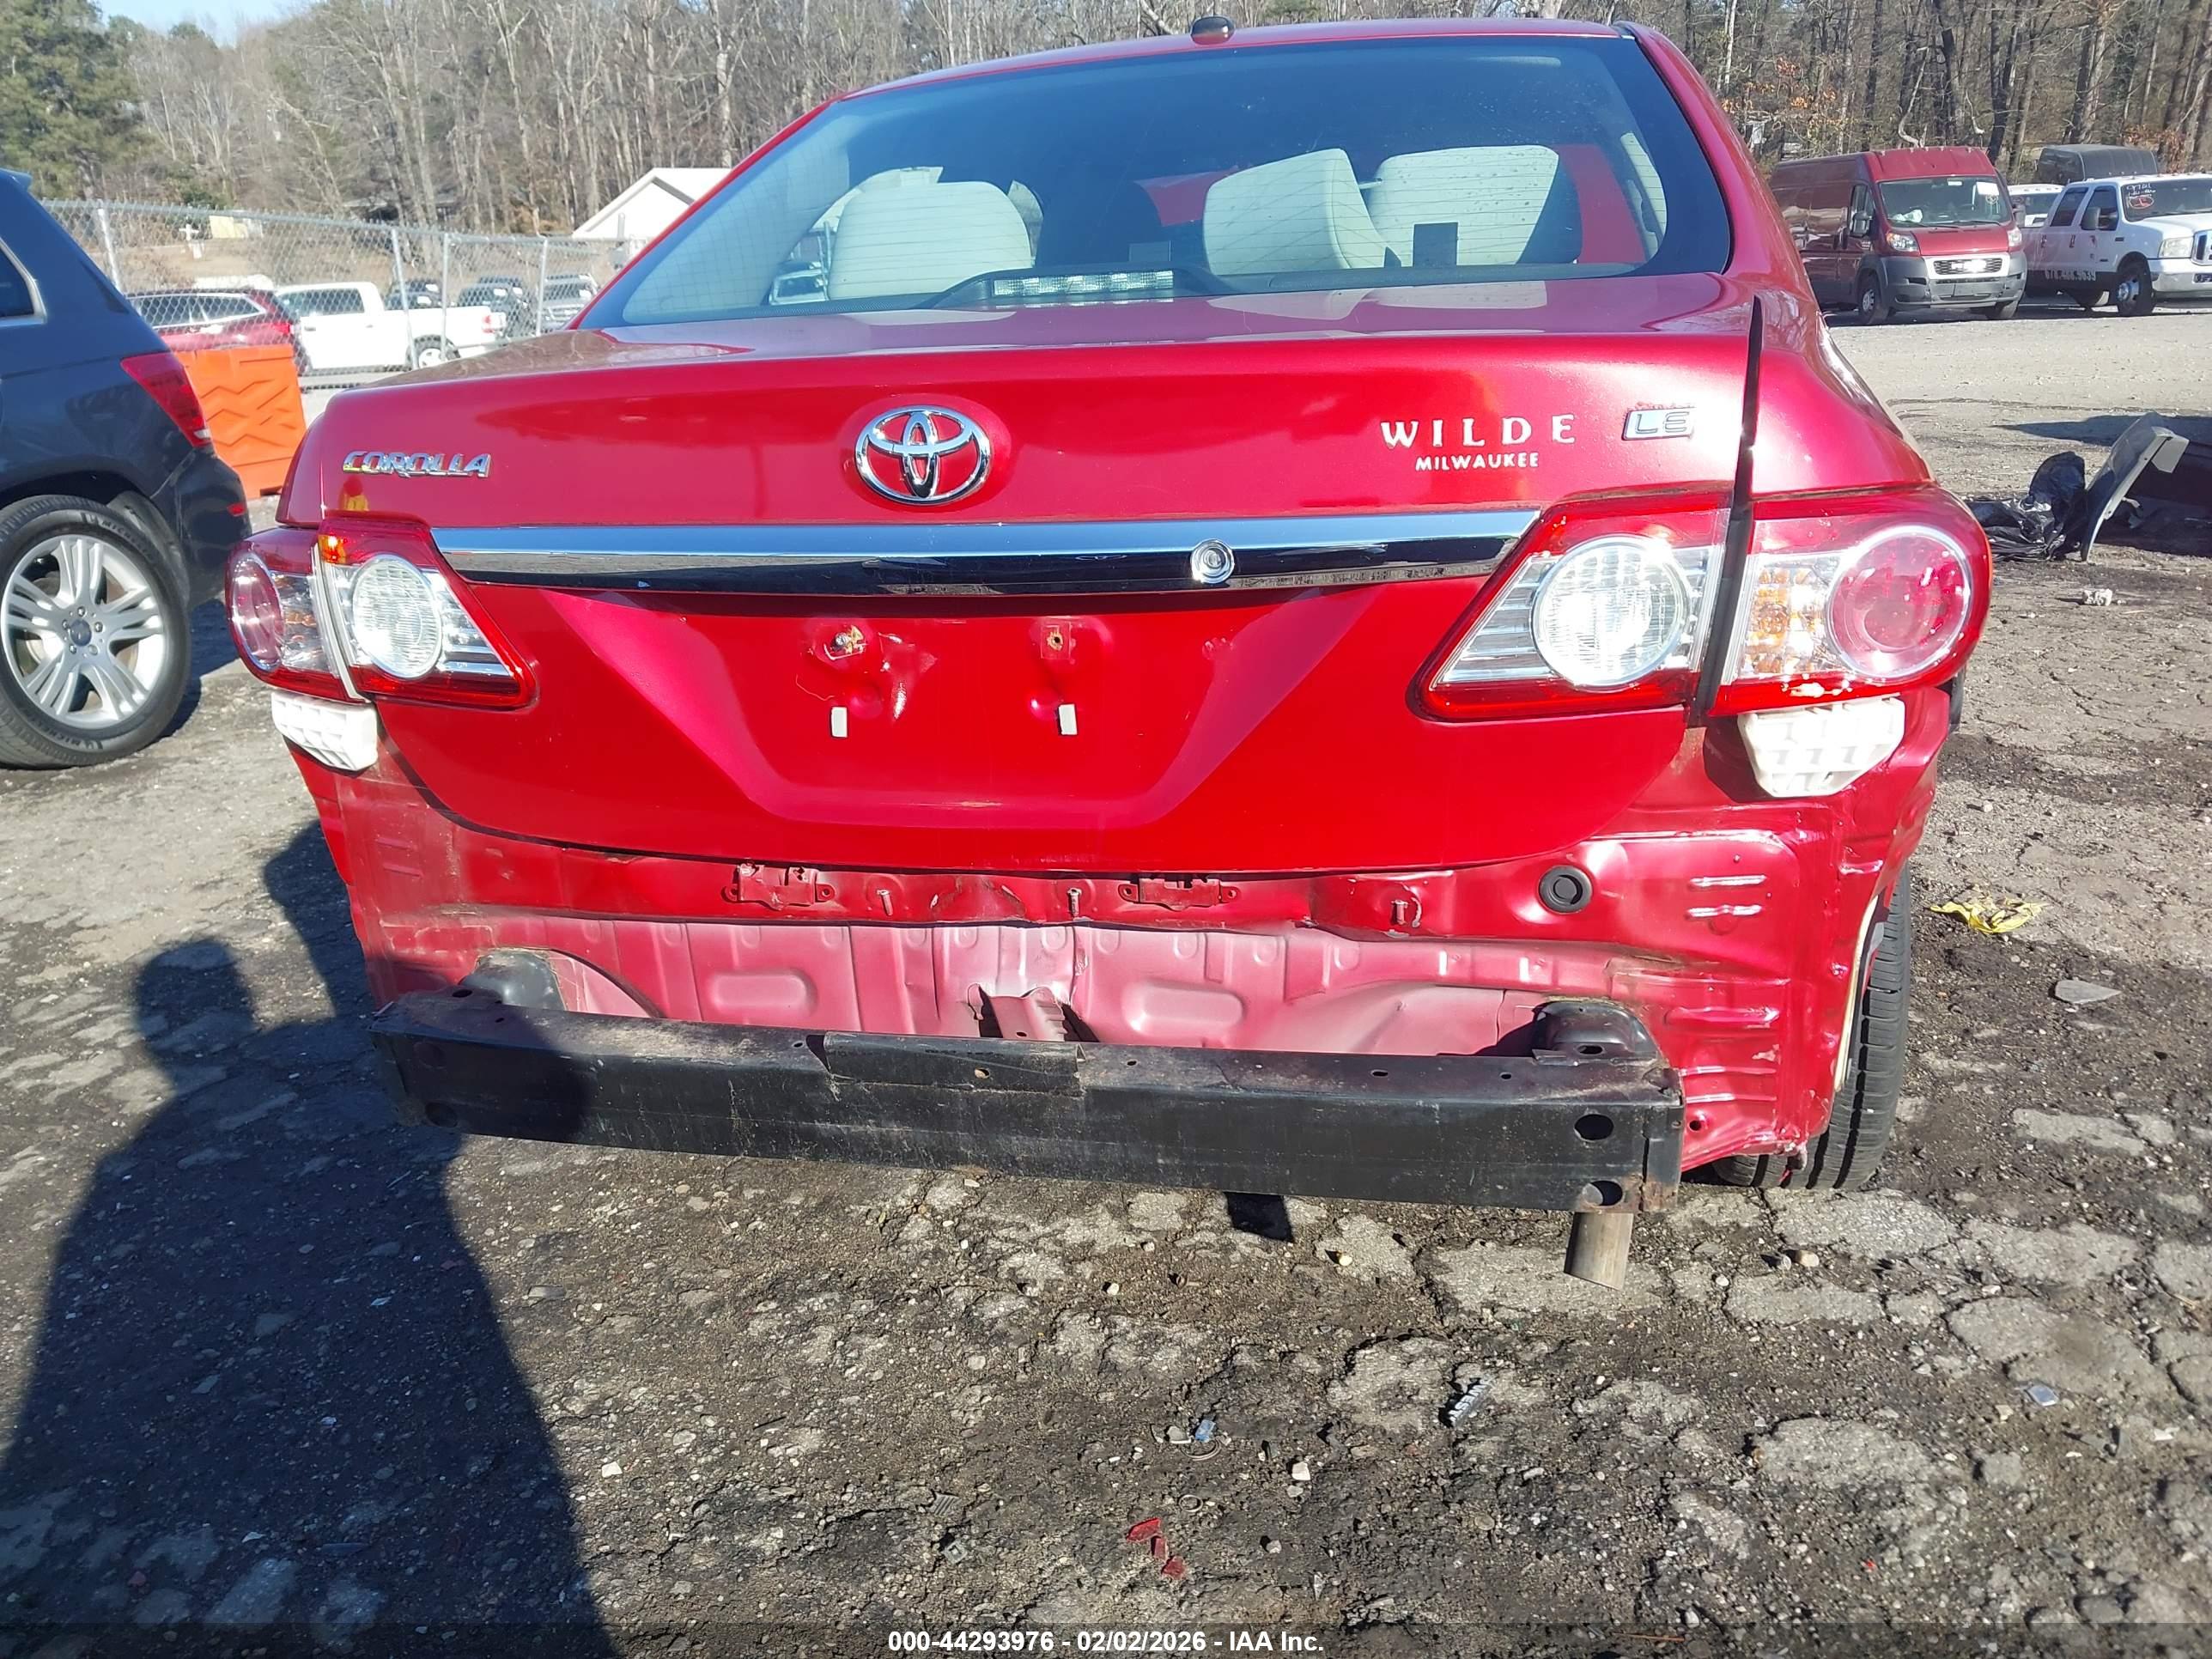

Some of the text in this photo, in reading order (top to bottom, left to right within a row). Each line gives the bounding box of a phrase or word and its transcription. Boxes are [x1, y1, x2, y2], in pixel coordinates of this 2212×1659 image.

[1380, 413, 1576, 449] WILDE
[1634, 411, 1690, 434] LE
[343, 451, 491, 477] COROLLA
[1415, 452, 1539, 471] MILWAUKEE
